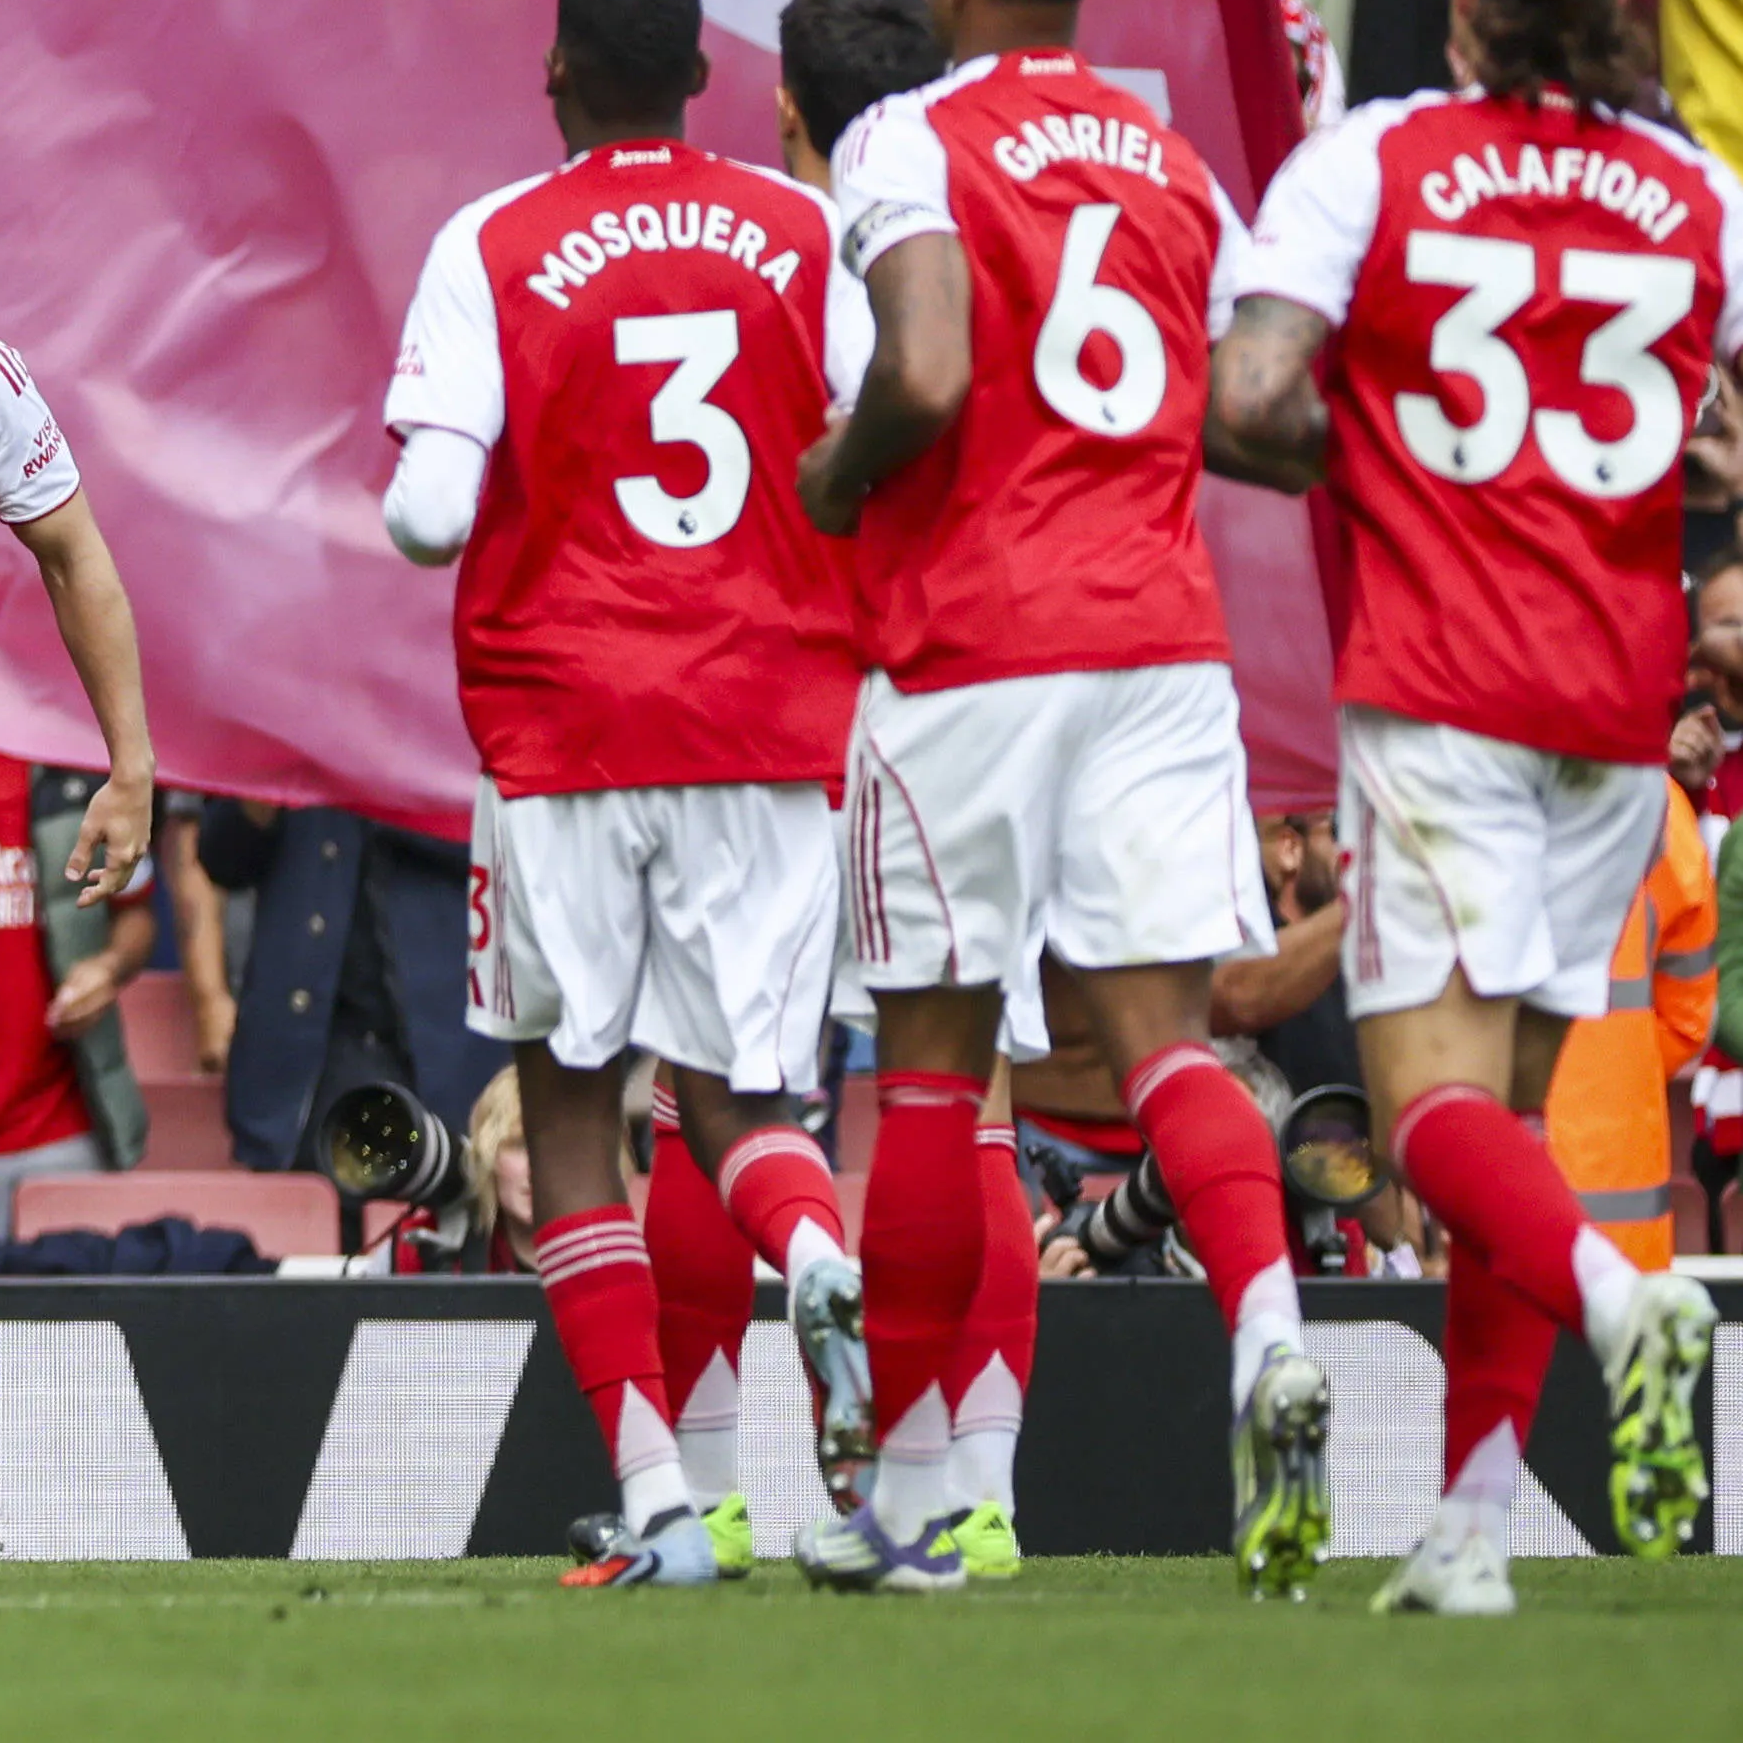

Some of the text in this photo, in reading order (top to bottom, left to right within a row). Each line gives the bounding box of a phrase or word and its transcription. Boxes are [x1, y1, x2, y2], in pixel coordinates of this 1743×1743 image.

[994, 112, 1169, 187] GABRIEL
[1421, 143, 1690, 243] CALAFIORI
[526, 203, 800, 309] MOSQUERA
[1034, 204, 1166, 437] 6
[615, 309, 751, 547] 3
[1394, 229, 1696, 498] 33
